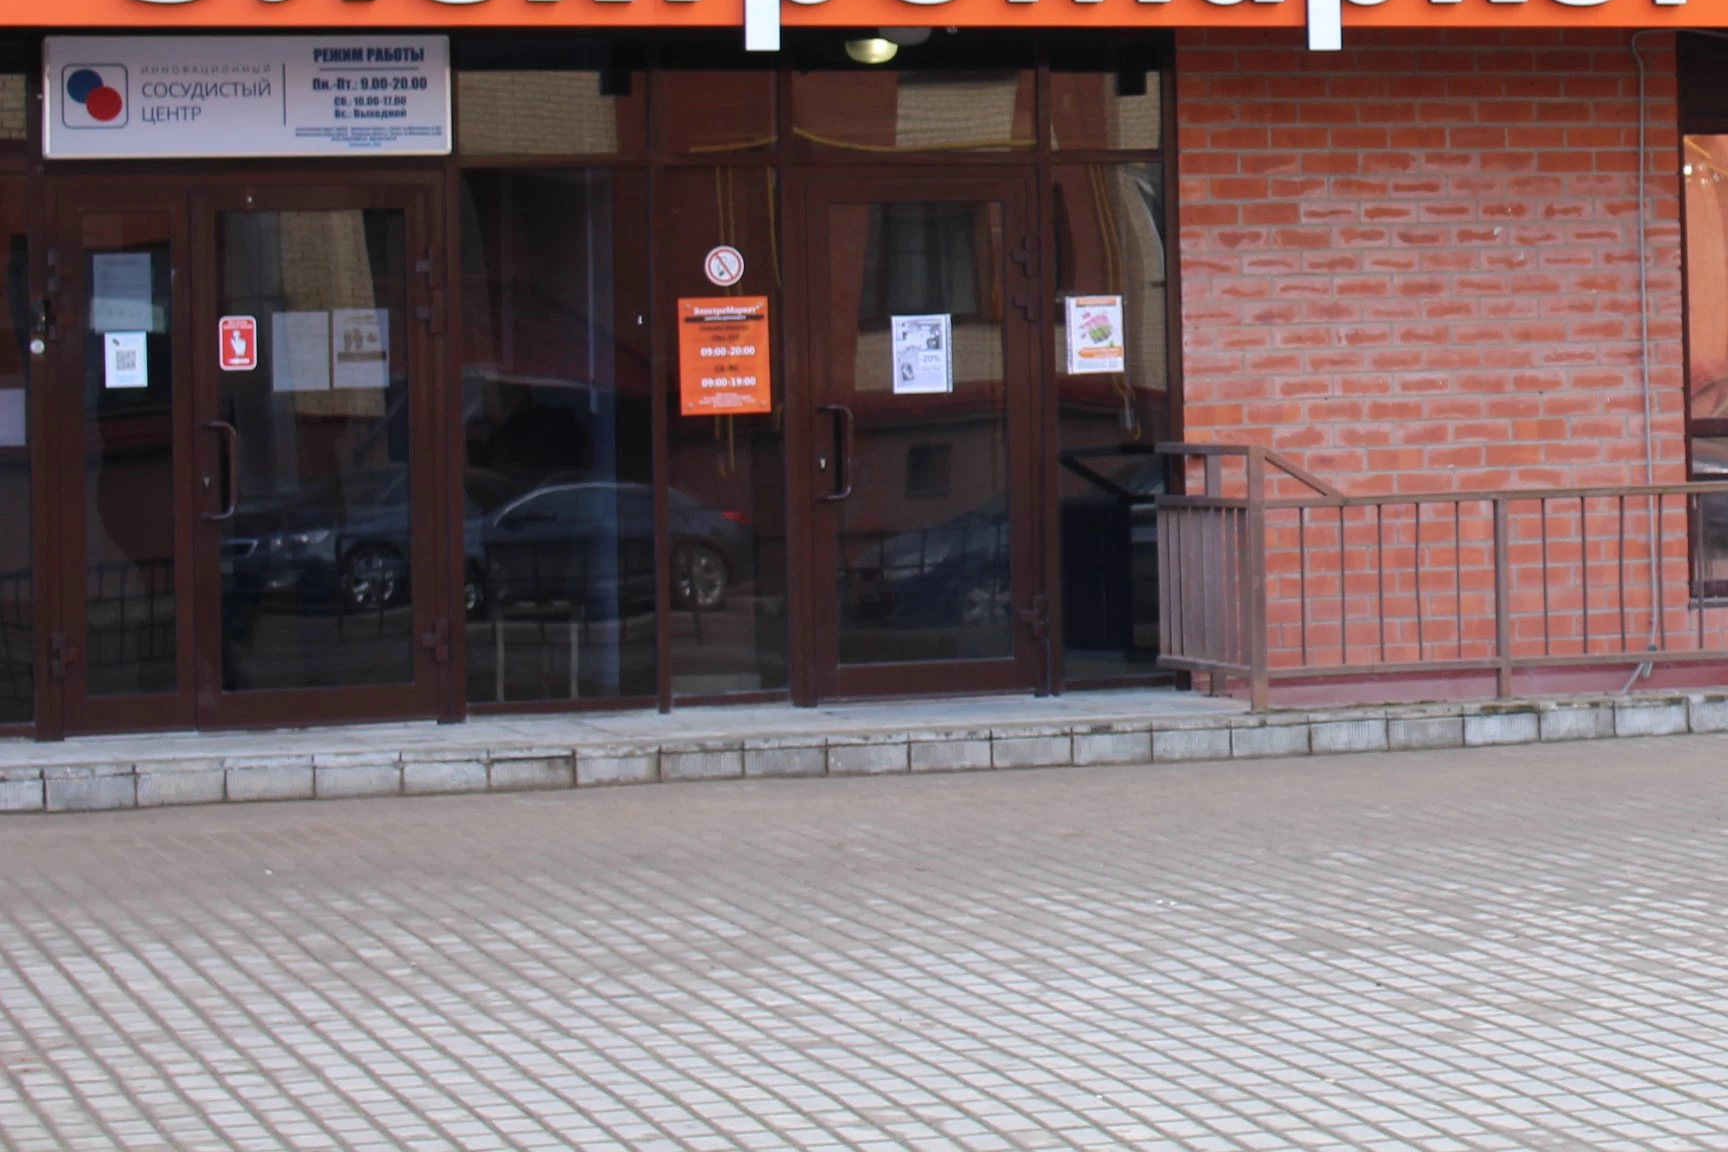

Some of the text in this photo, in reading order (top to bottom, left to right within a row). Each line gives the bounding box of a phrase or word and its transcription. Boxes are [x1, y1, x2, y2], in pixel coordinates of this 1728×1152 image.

[313, 47, 425, 63] РЕЖИМ РАБОТЫ
[141, 78, 272, 101] СОСУДИСТЫЙ
[141, 106, 202, 125] ЦЕНТР
